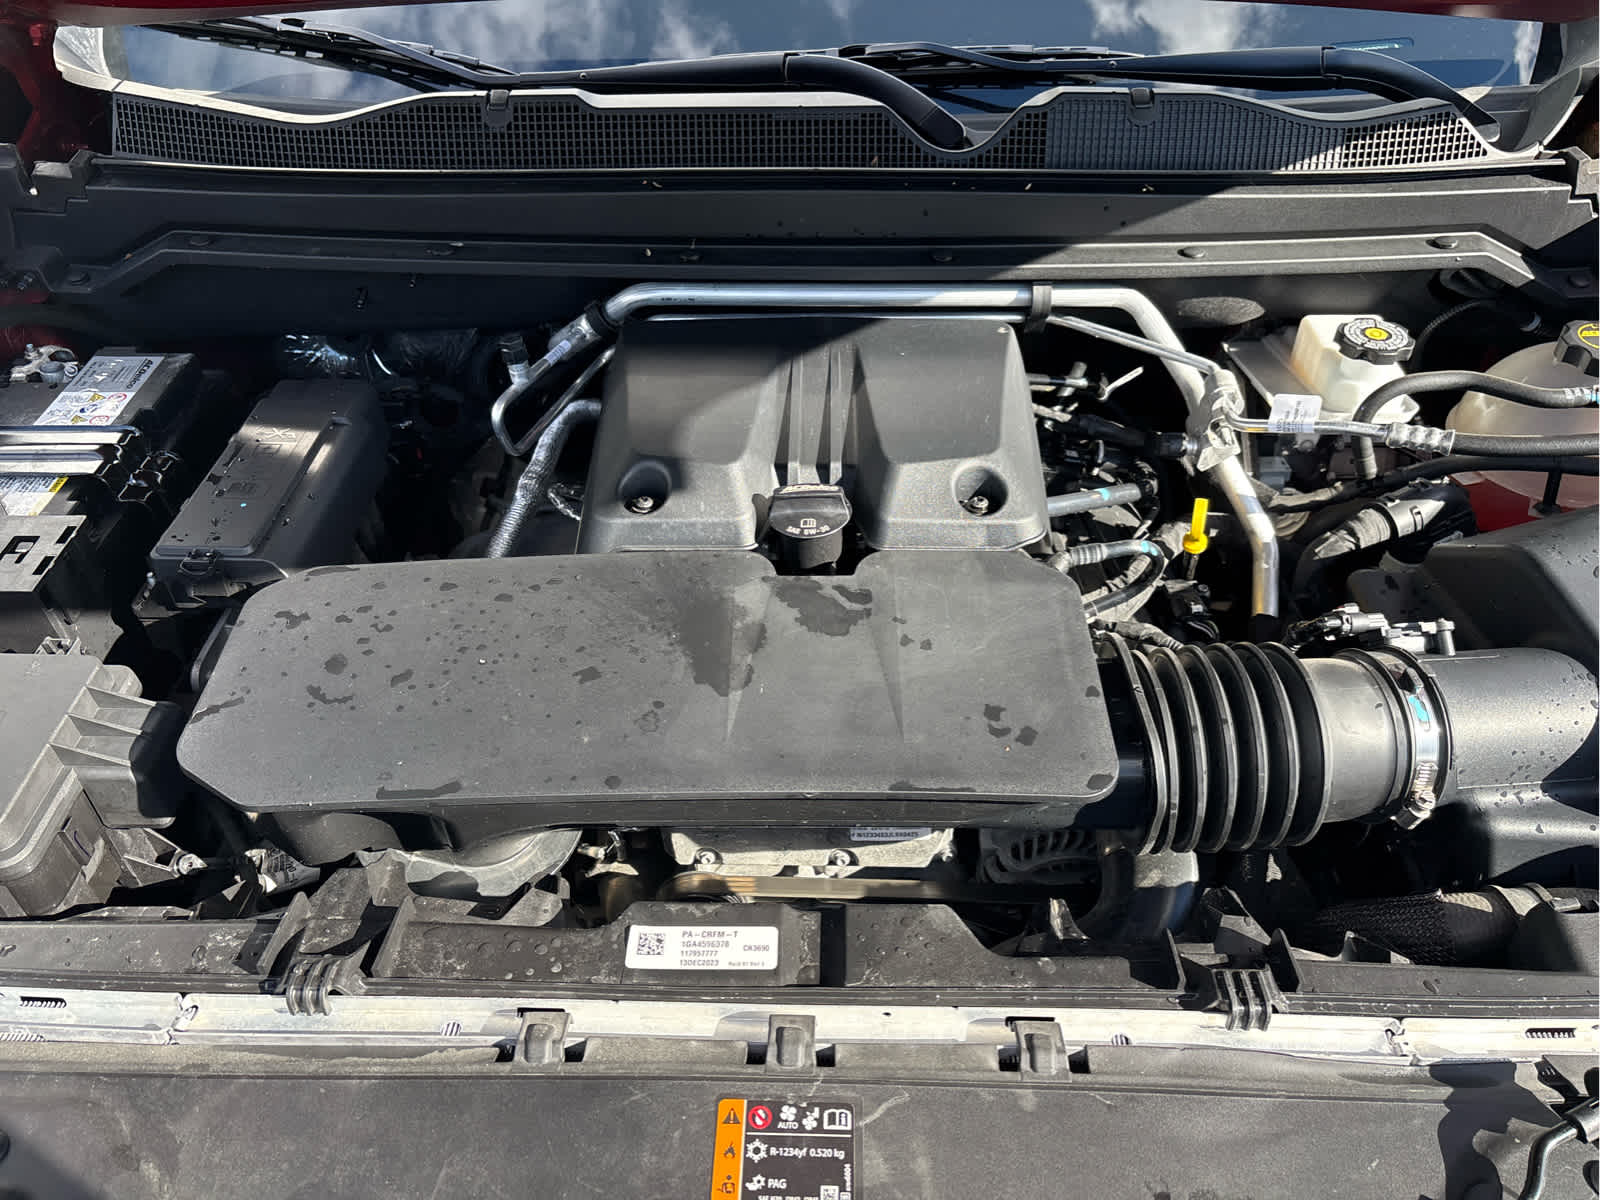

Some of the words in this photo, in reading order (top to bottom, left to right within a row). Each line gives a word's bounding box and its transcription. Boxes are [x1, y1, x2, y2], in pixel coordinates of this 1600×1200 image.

[679, 959, 720, 967] 13DEC2023
[777, 1122, 799, 1130] AUTO
[769, 1147, 807, 1159] R-1234yf
[809, 1148, 833, 1158] 0.520
[833, 1148, 845, 1160] kg
[768, 1178, 787, 1189] PAG
